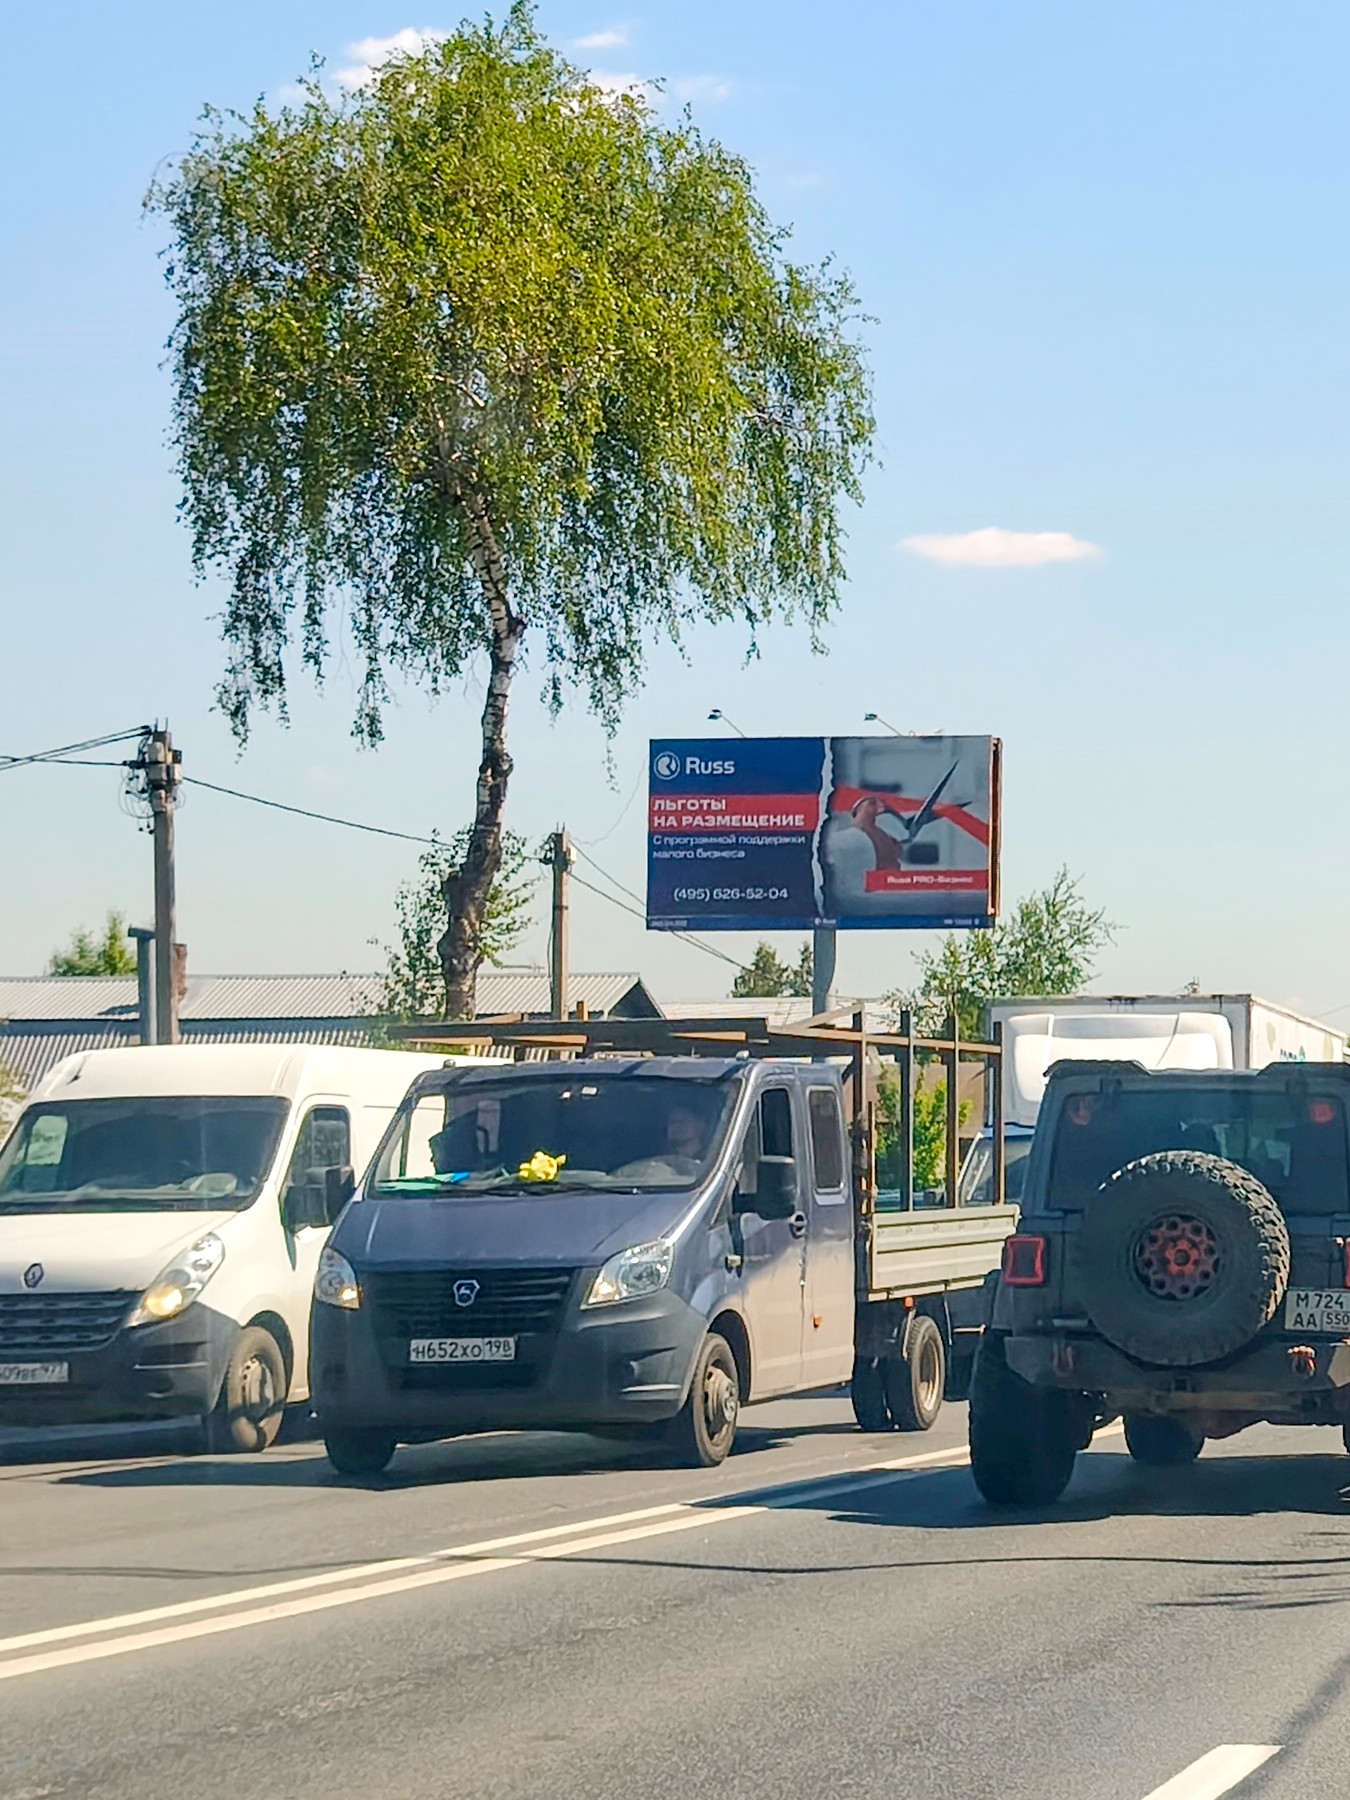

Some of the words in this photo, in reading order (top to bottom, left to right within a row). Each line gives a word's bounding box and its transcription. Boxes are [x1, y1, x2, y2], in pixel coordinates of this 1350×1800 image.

[685, 756, 736, 775] Russ
[653, 798, 727, 811] ЛЬГОТЫ
[653, 815, 678, 827] НА
[682, 814, 805, 828] РАЗМЕЩЕНИЕ
[653, 835, 662, 845] С
[664, 834, 736, 847] программой
[739, 835, 806, 846] поддержки
[653, 850, 694, 858] малого
[696, 848, 746, 858] бизнеса
[674, 887, 710, 902] (495)
[713, 887, 789, 900] 626-52-04
[1313, 1293, 1344, 1310] 724
[1293, 1312, 1317, 1328] АА
[1325, 1312, 1350, 1326] 550
[412, 1341, 482, 1359] Н652ХО
